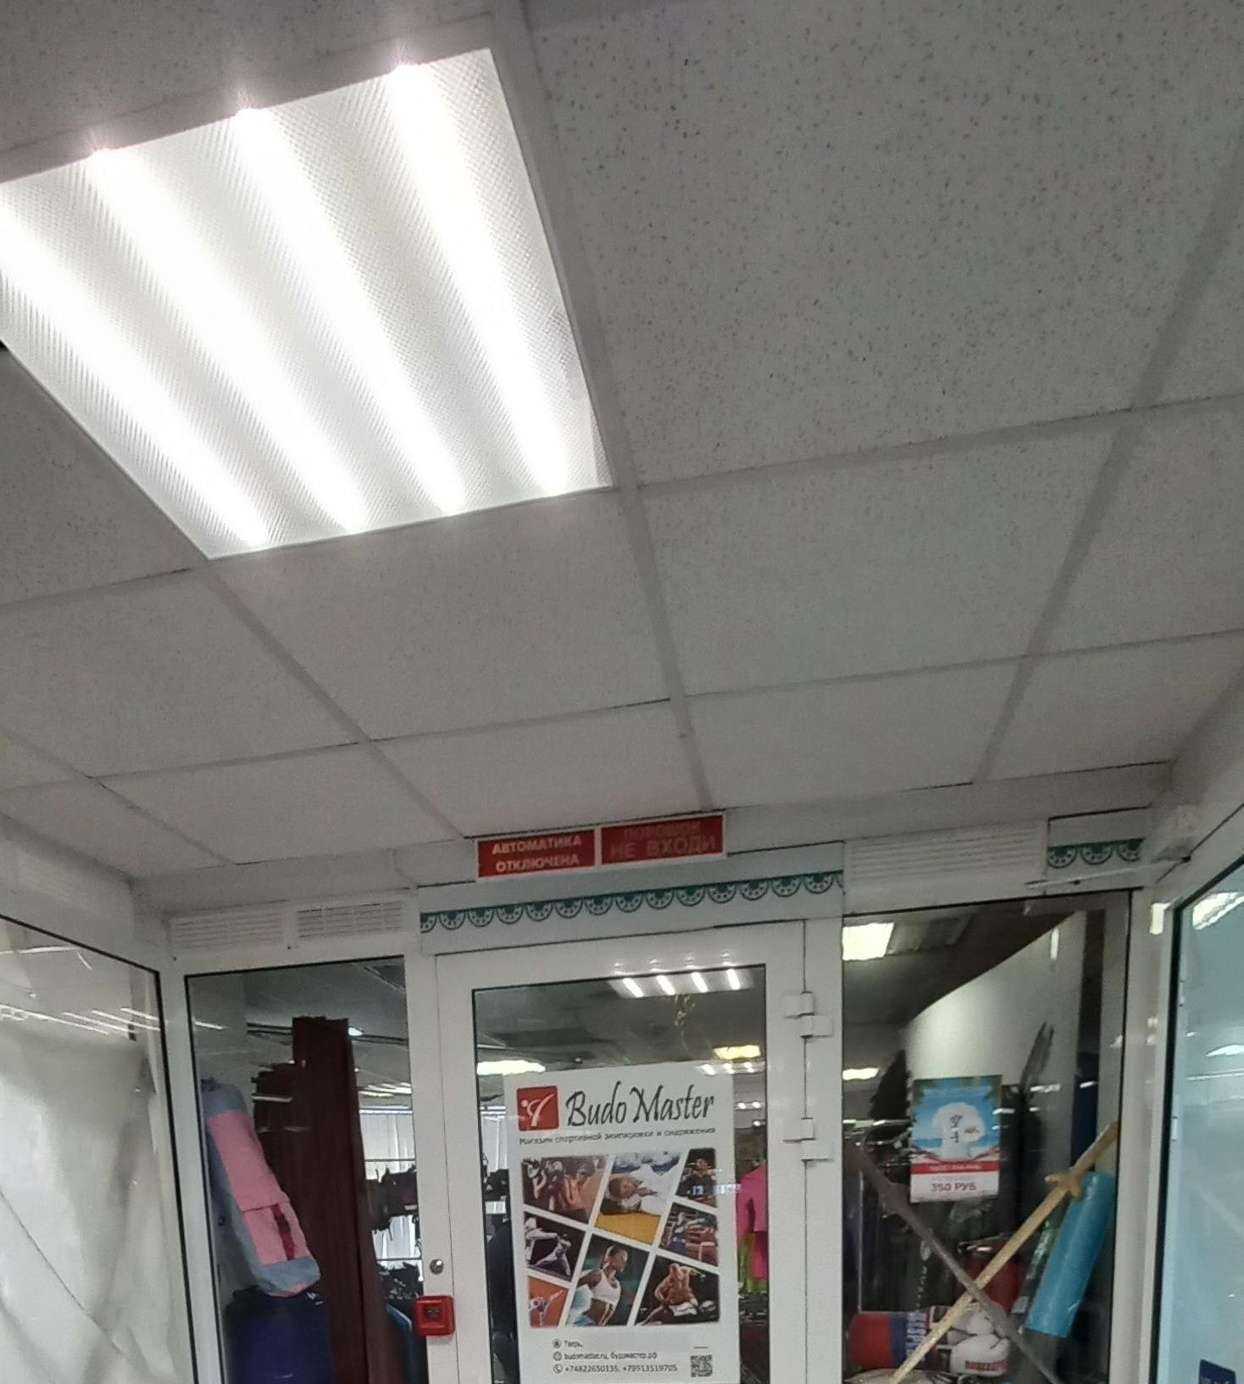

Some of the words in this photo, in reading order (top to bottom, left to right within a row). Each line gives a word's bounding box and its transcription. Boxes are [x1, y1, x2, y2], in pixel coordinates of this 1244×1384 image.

[492, 836, 582, 856] АВТОМАТИКА
[611, 841, 637, 859] НЕ
[647, 835, 717, 857] ВХОДИ
[495, 854, 580, 873] ОТКЛЮЧЕНА
[565, 1081, 626, 1127] Budo
[629, 1084, 714, 1124] Master
